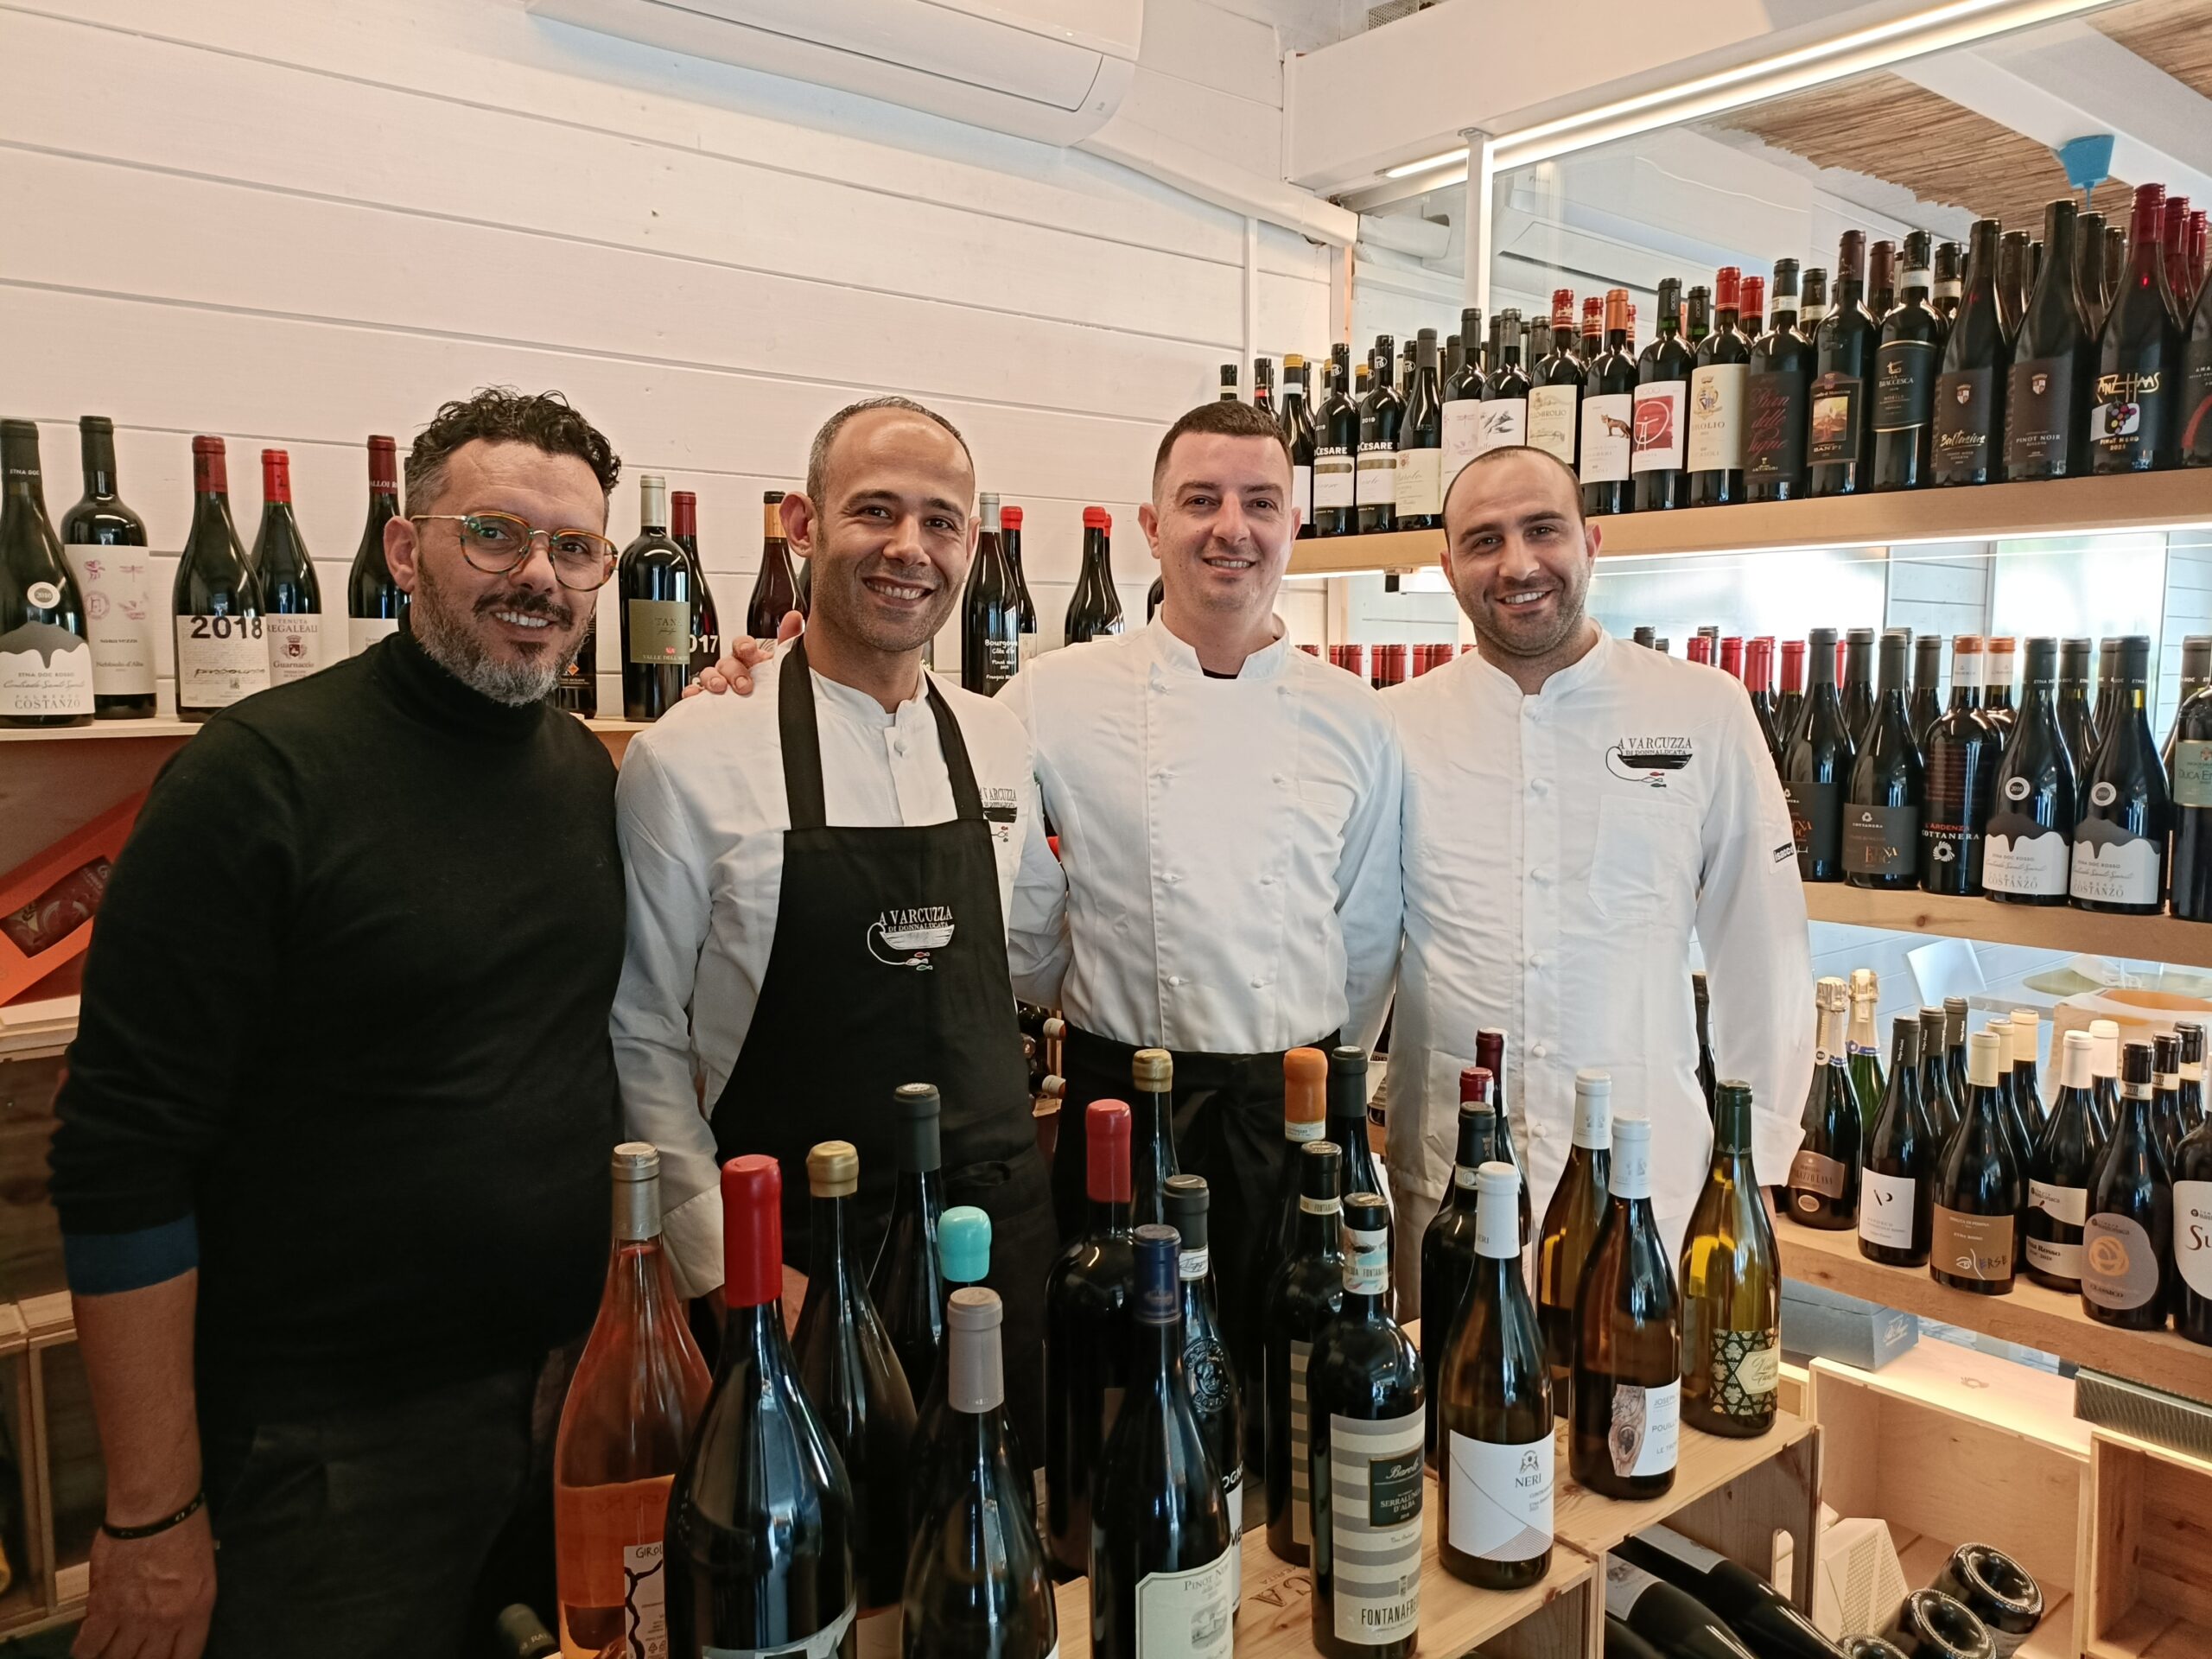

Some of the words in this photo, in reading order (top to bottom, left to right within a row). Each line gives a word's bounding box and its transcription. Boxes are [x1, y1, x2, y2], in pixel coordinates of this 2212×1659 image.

[1878, 378, 1914, 387] BRACCESCA
[1316, 446, 1348, 456] CESARE
[1360, 442, 1393, 452] CESARE
[190, 615, 263, 639] 2018
[267, 623, 318, 633] REGALEALI
[15, 700, 80, 709] COSTANZO
[1618, 737, 1624, 750] A
[1628, 737, 1694, 749] VARCUZZA
[983, 787, 1016, 802] VARCUZZA
[1925, 823, 1970, 831] L'ARDENZA
[1922, 830, 1980, 840] COTTANERA
[1987, 876, 2038, 889] COSTANZO
[880, 912, 888, 926] A
[889, 906, 954, 925] VARCUZZA
[899, 921, 949, 931] DONNALUCATA
[2037, 1245, 2061, 1256] Rosso
[1980, 1255, 2008, 1270] ERSE
[1385, 1457, 1419, 1479] Barolo
[1516, 1472, 1541, 1488] NERI
[1393, 1500, 1415, 1513] D'ALBA
